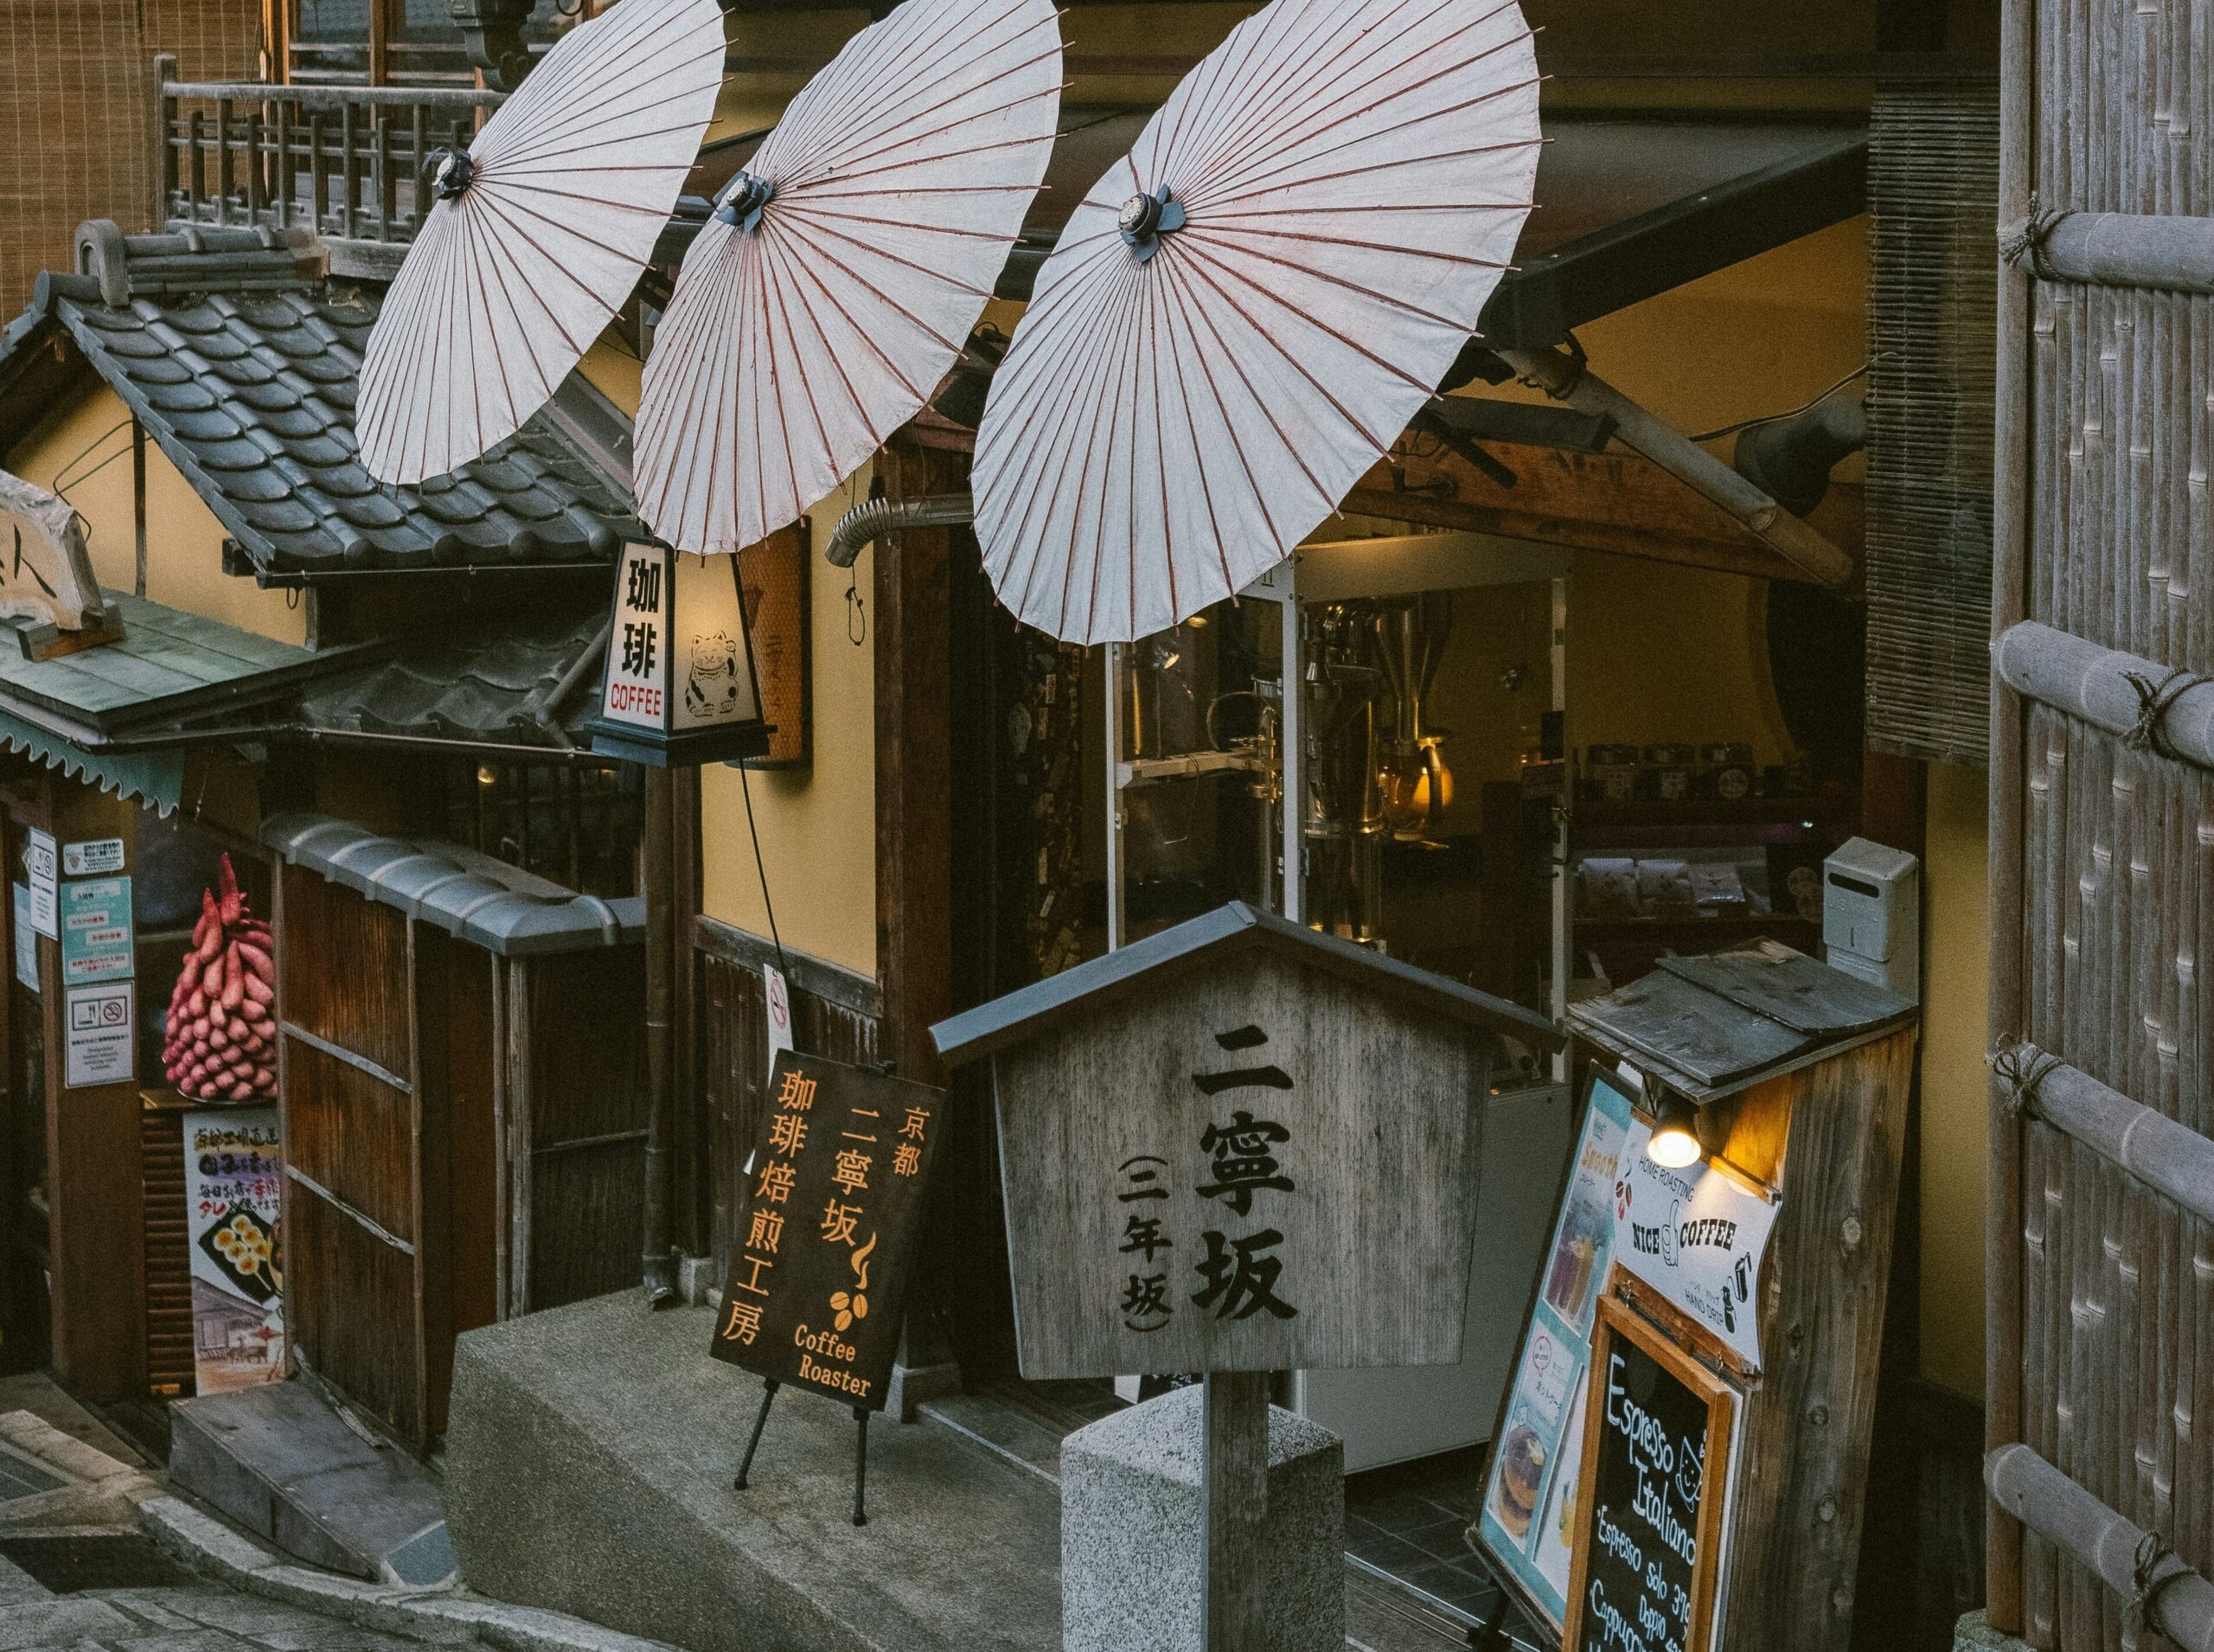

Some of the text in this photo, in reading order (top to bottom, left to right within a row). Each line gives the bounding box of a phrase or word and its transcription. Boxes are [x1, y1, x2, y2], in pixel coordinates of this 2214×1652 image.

[622, 558, 662, 679] 珈琲
[611, 683, 662, 717] COFFEE
[893, 1105, 931, 1178] 京都
[1191, 1024, 1298, 1320] 二寧坂
[723, 1069, 817, 1348] 珈琲焙煎工房
[820, 1107, 880, 1247] 二寧坂
[1639, 1155, 1695, 1203] HOME ROASTING
[1117, 1156, 1174, 1333] （二年坂）
[1632, 1218, 1737, 1255] NICE COFFEE
[1684, 1288, 1724, 1326] HAND DRIP
[795, 1324, 855, 1362] Coffee
[798, 1354, 871, 1399] Roaster
[1607, 1353, 1673, 1474] Espresso
[1598, 1505, 1641, 1572] Espresso
[1633, 1463, 1696, 1566] Italiano
[1639, 1594, 1666, 1642] Doppio
